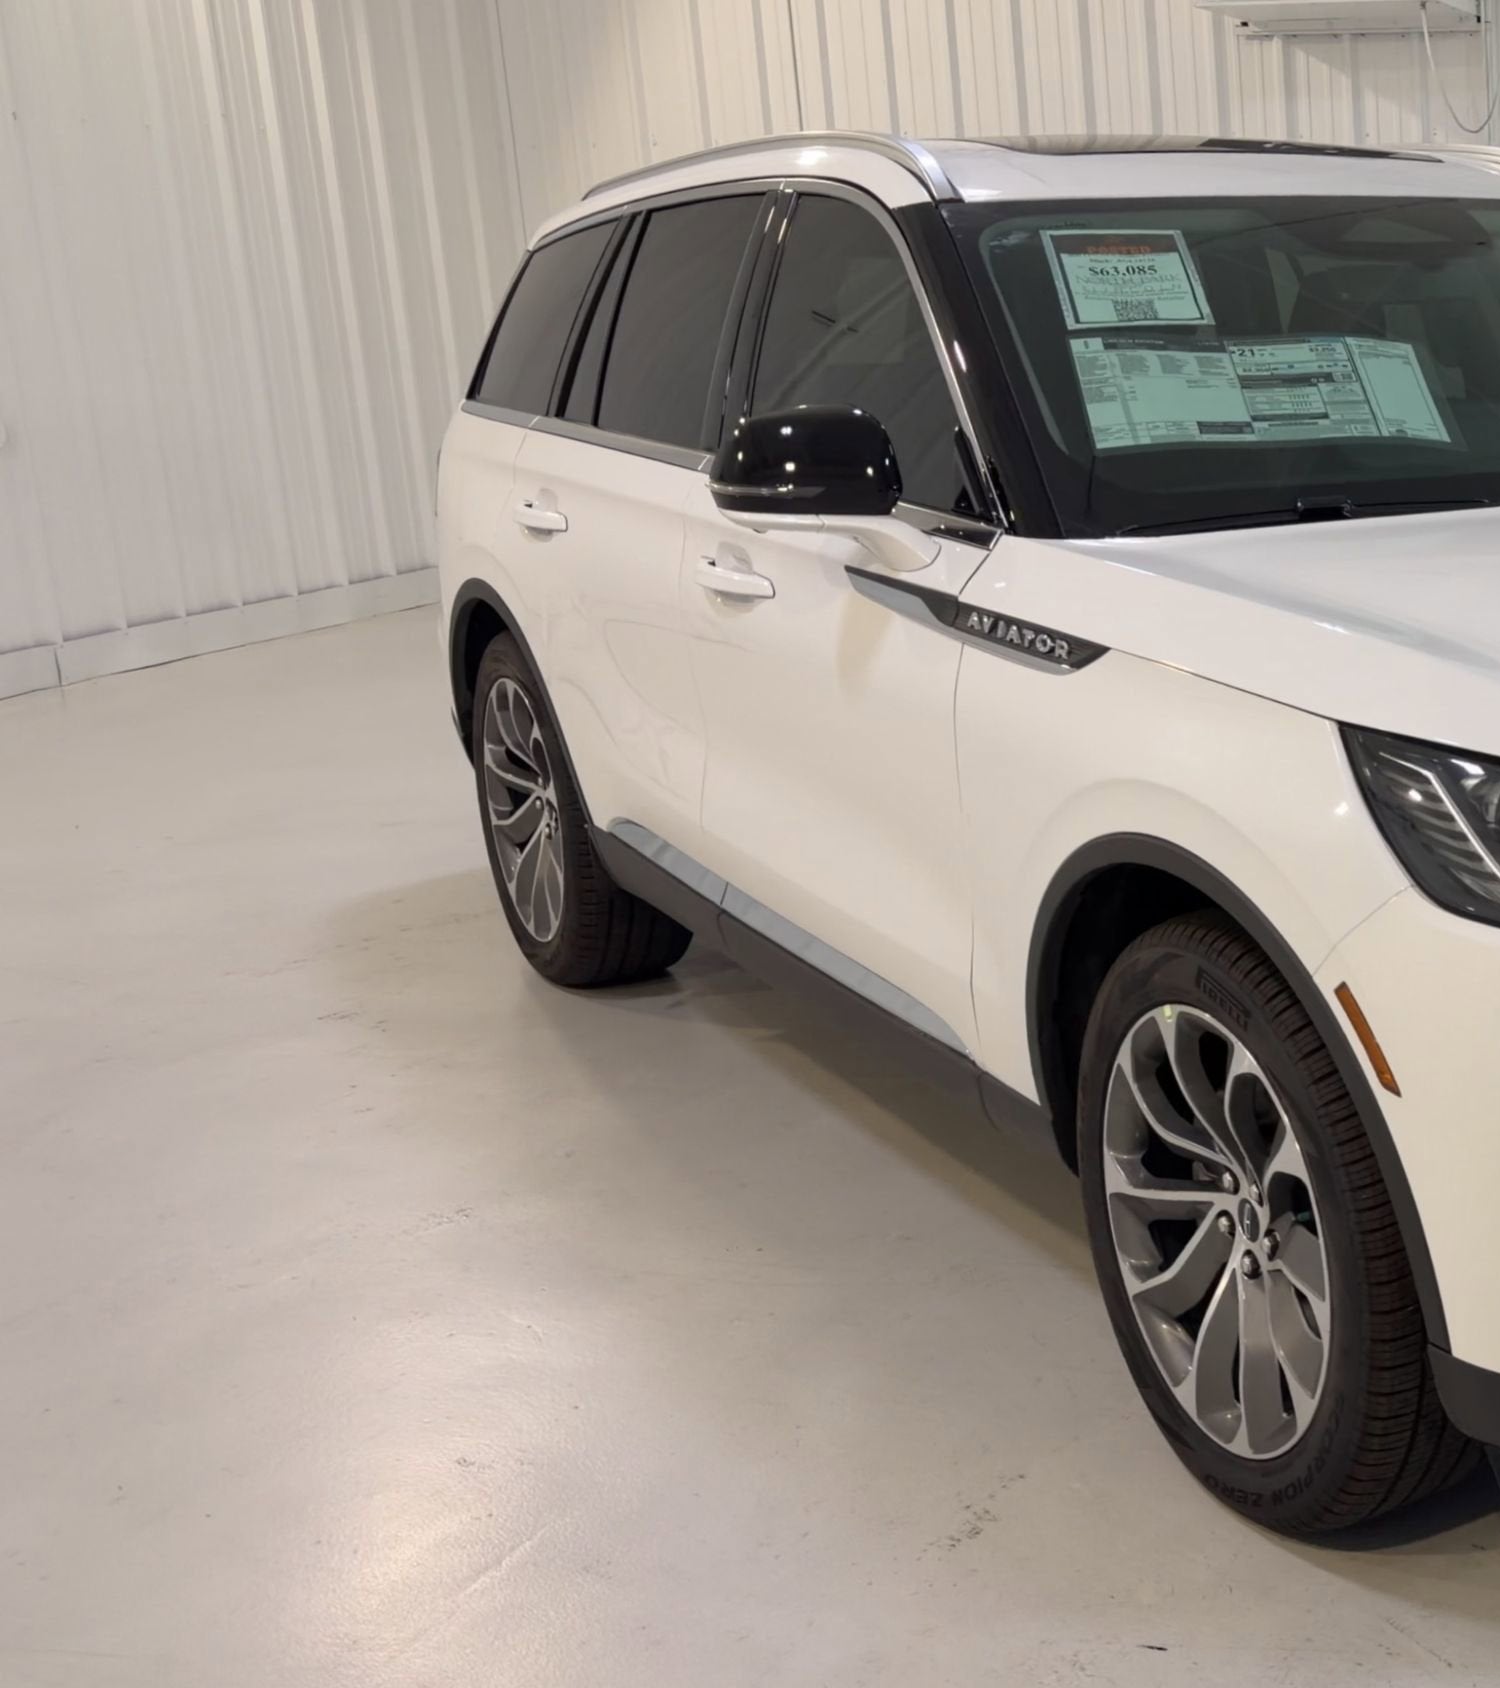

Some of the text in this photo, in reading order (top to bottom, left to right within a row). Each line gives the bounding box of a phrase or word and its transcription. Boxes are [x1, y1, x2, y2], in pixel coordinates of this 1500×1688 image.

[1088, 264, 1158, 276] $63,085
[1237, 348, 1255, 357] 21
[967, 611, 1071, 660] AVIATOR
[1195, 964, 1251, 1032] PIRELLI
[1204, 1473, 1265, 1507] ZERO
